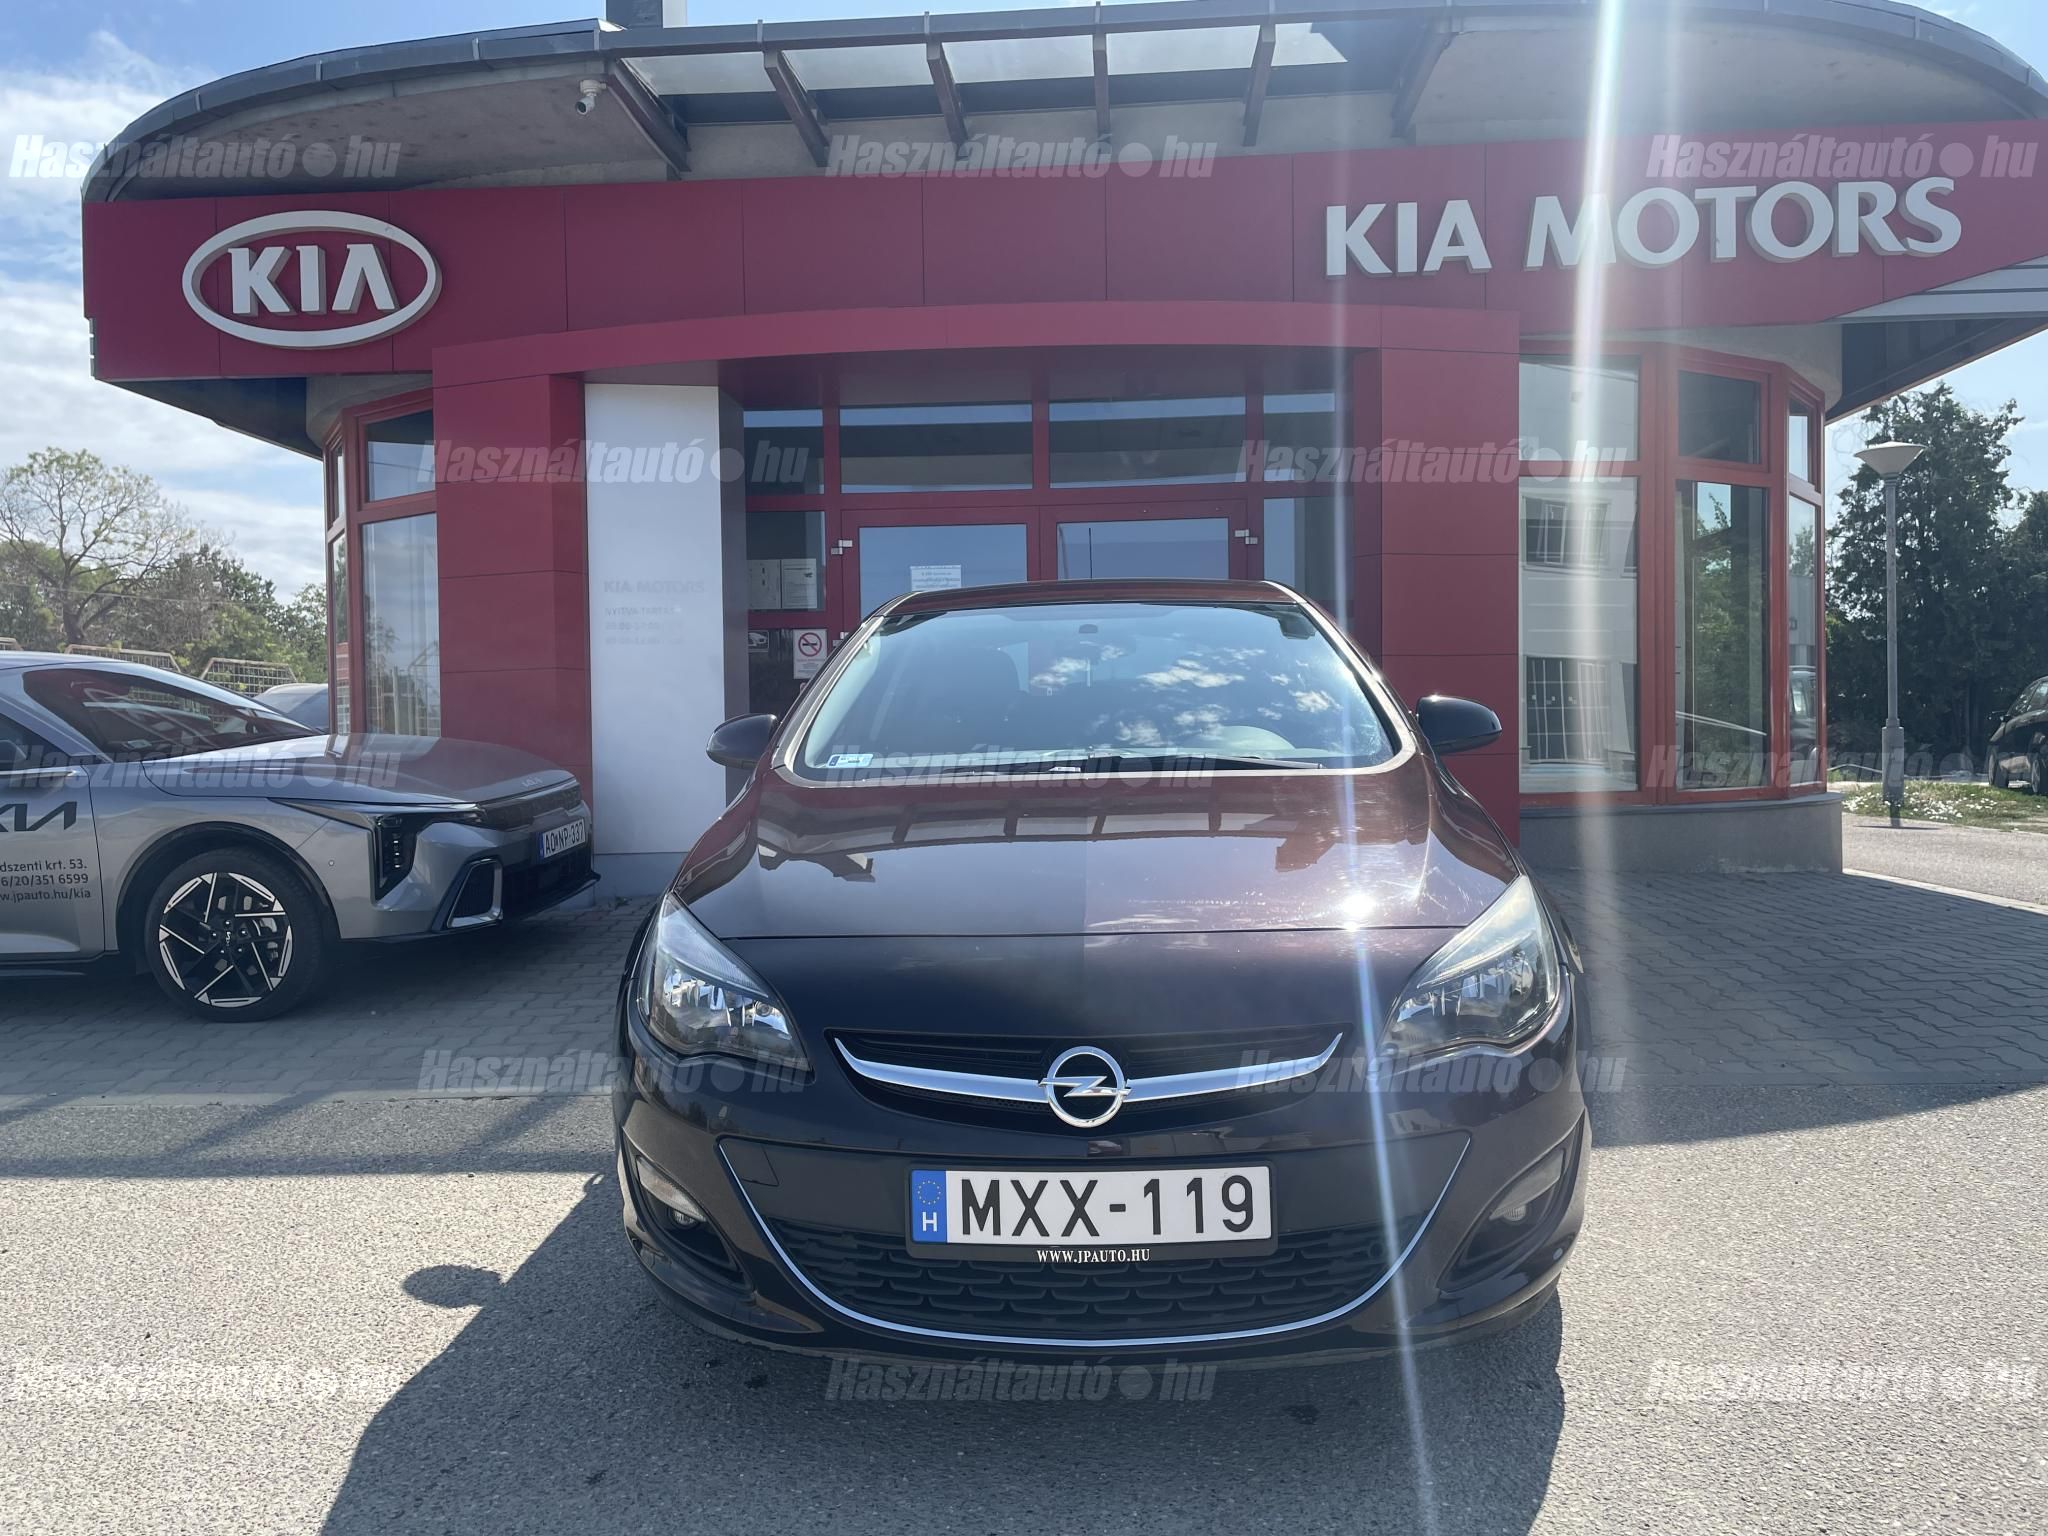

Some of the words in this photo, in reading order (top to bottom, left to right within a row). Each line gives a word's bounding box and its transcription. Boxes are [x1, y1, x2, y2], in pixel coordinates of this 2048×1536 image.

[1324, 199, 1492, 280] KIA
[1523, 176, 1964, 271] MOTORS
[226, 243, 402, 316] KIA
[45, 859, 66, 871] krt.
[69, 858, 88, 869] 53.
[58, 873, 89, 884] 6599
[922, 1211, 938, 1232] H
[960, 1174, 1255, 1238] MXX-119
[1036, 1248, 1151, 1264] WWW.JPAUTO.HU
